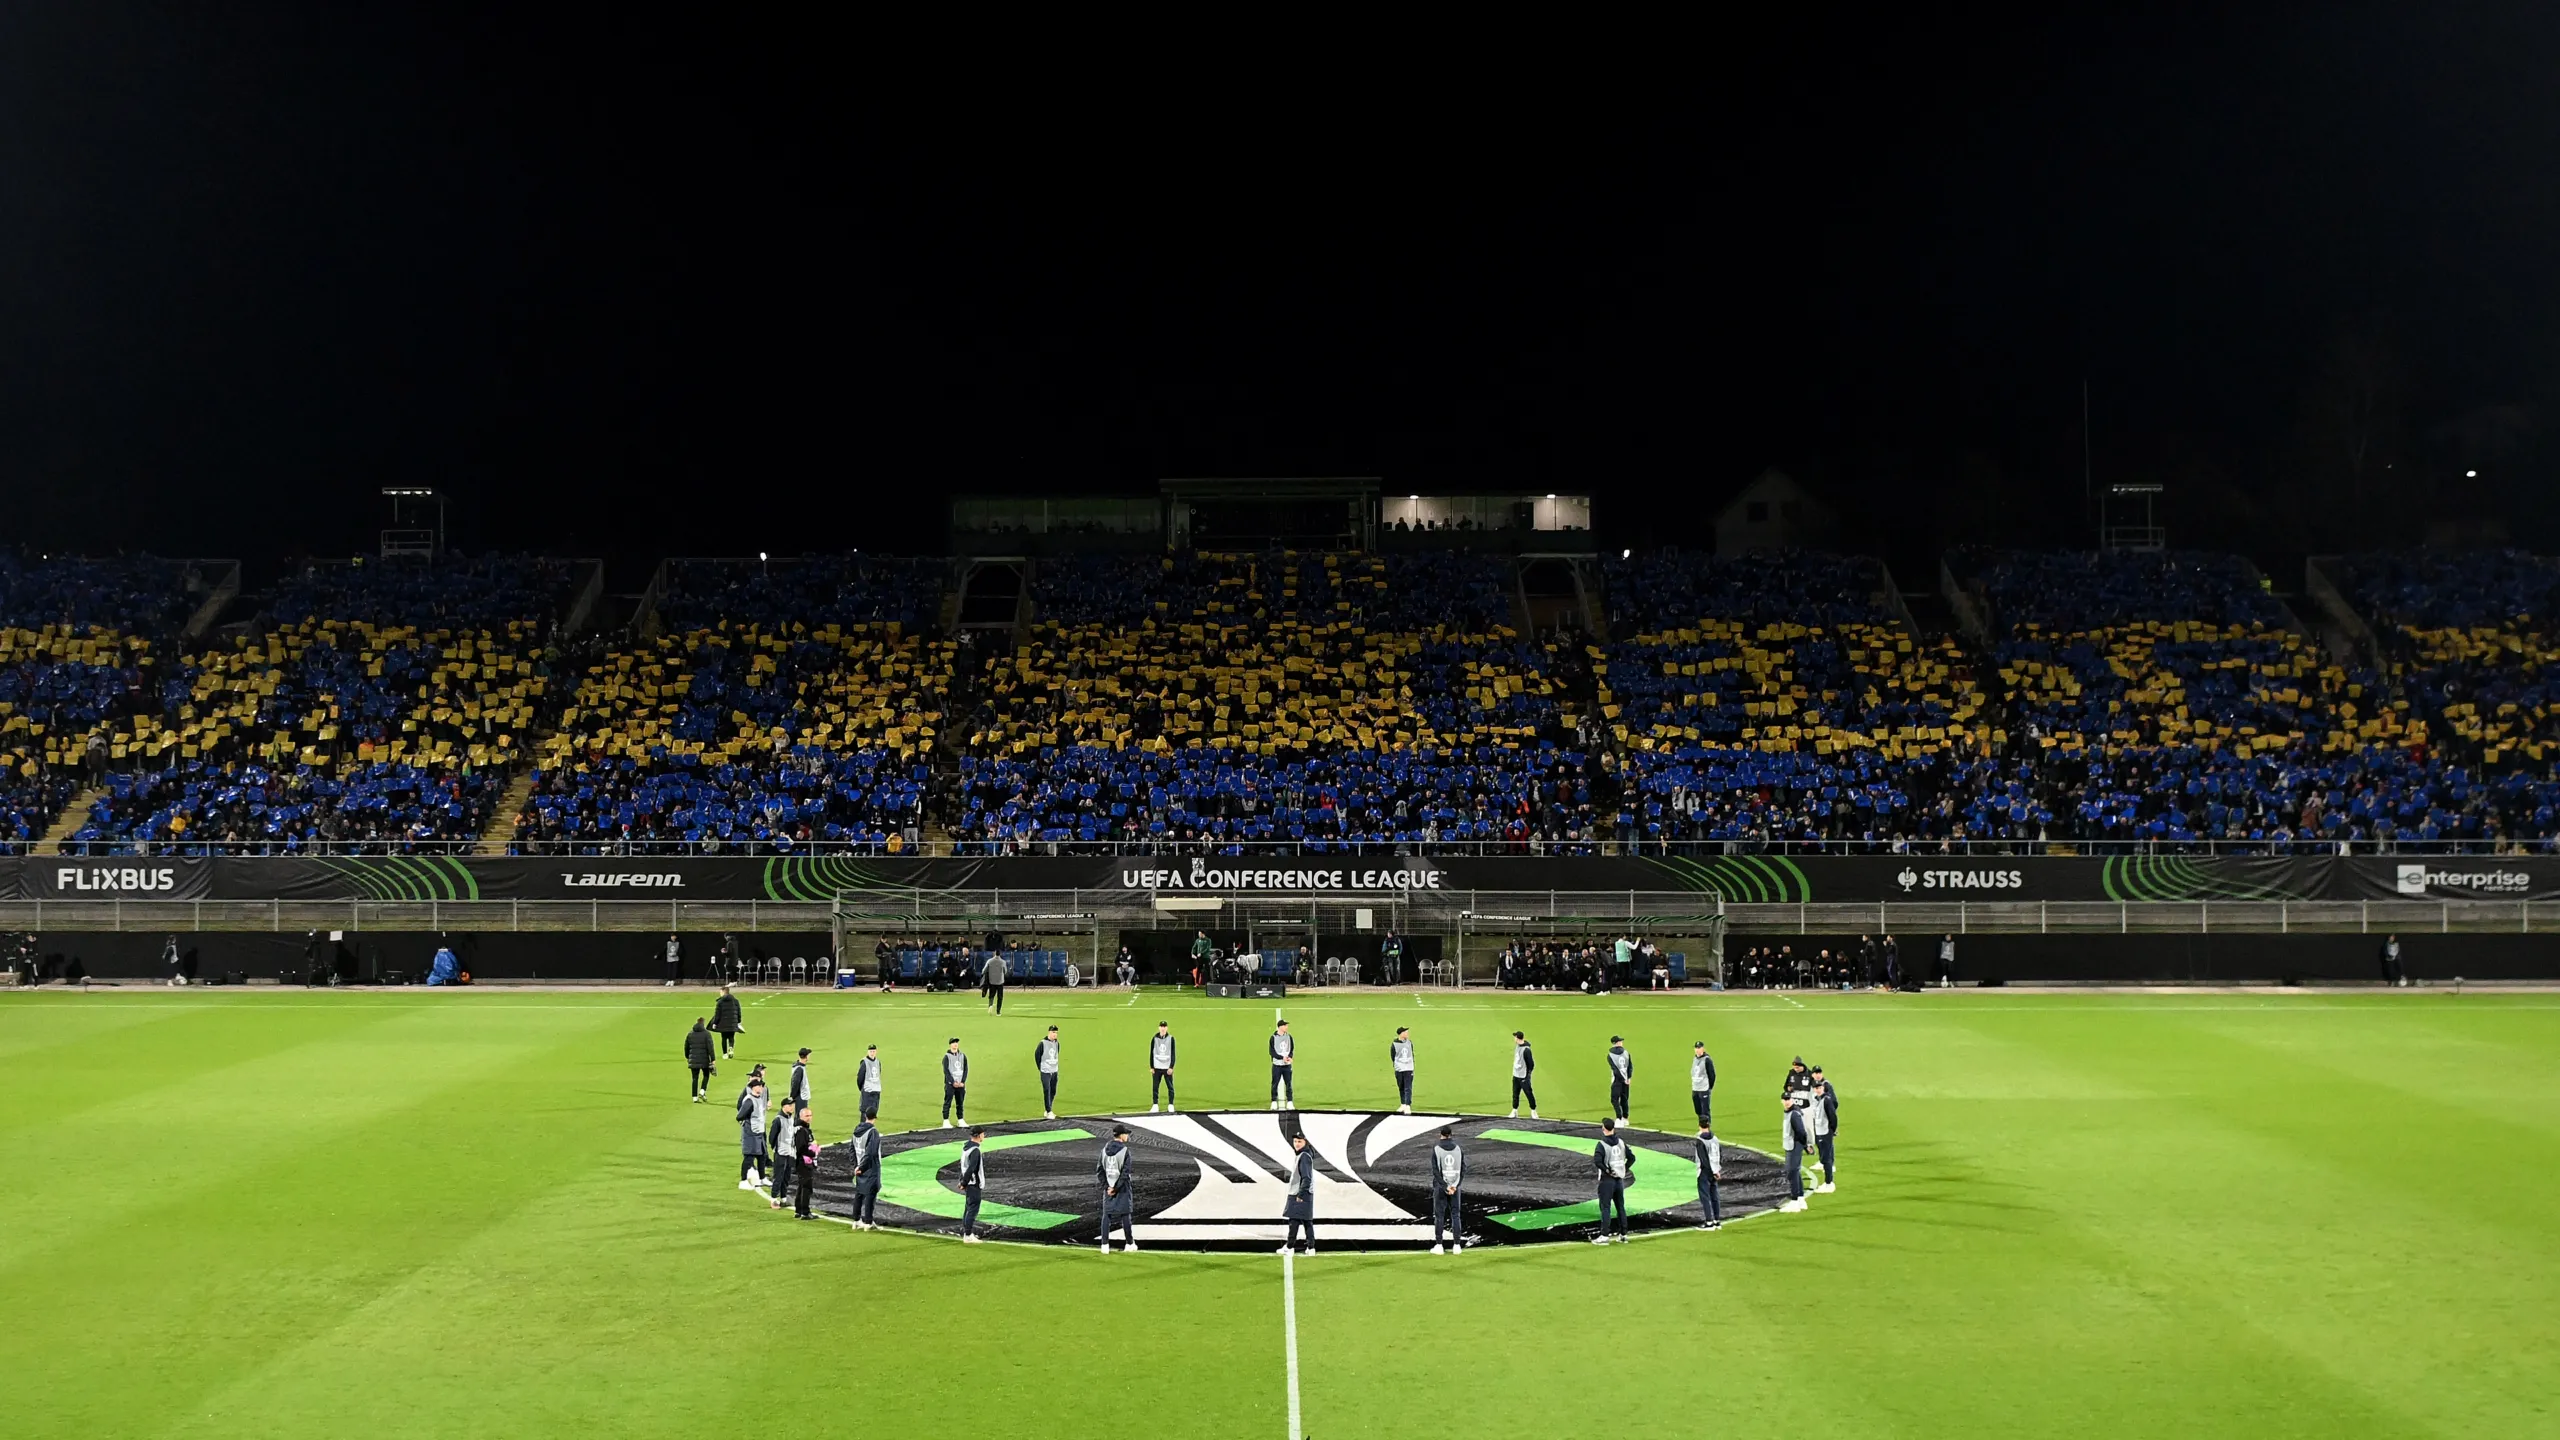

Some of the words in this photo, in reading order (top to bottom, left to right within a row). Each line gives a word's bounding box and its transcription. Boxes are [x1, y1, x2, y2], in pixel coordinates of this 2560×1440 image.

[1123, 869, 1186, 889] UEFA
[1189, 869, 1343, 889] CONFERENCE
[1922, 870, 2022, 889] STRAUSS
[2403, 869, 2530, 889] enterprise
